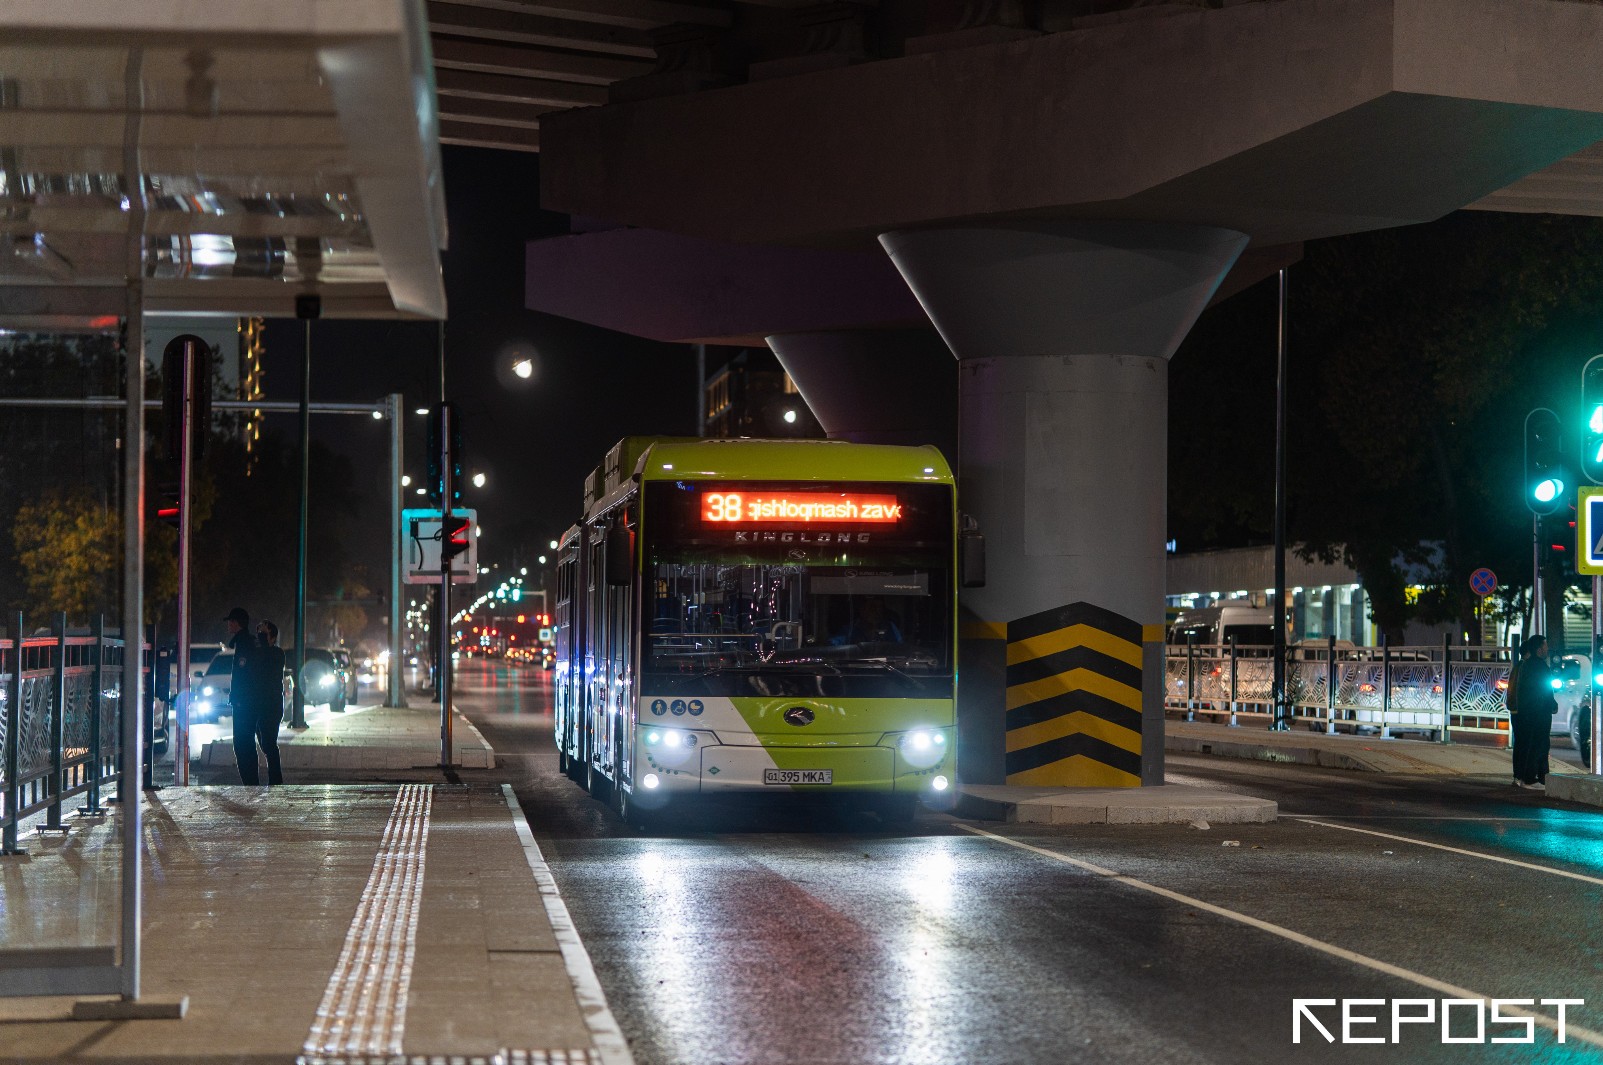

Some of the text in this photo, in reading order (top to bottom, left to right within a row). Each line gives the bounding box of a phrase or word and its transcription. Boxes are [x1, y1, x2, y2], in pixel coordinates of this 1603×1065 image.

[707, 494, 741, 521] 38
[780, 771, 800, 782] 395
[802, 771, 825, 782] MKA
